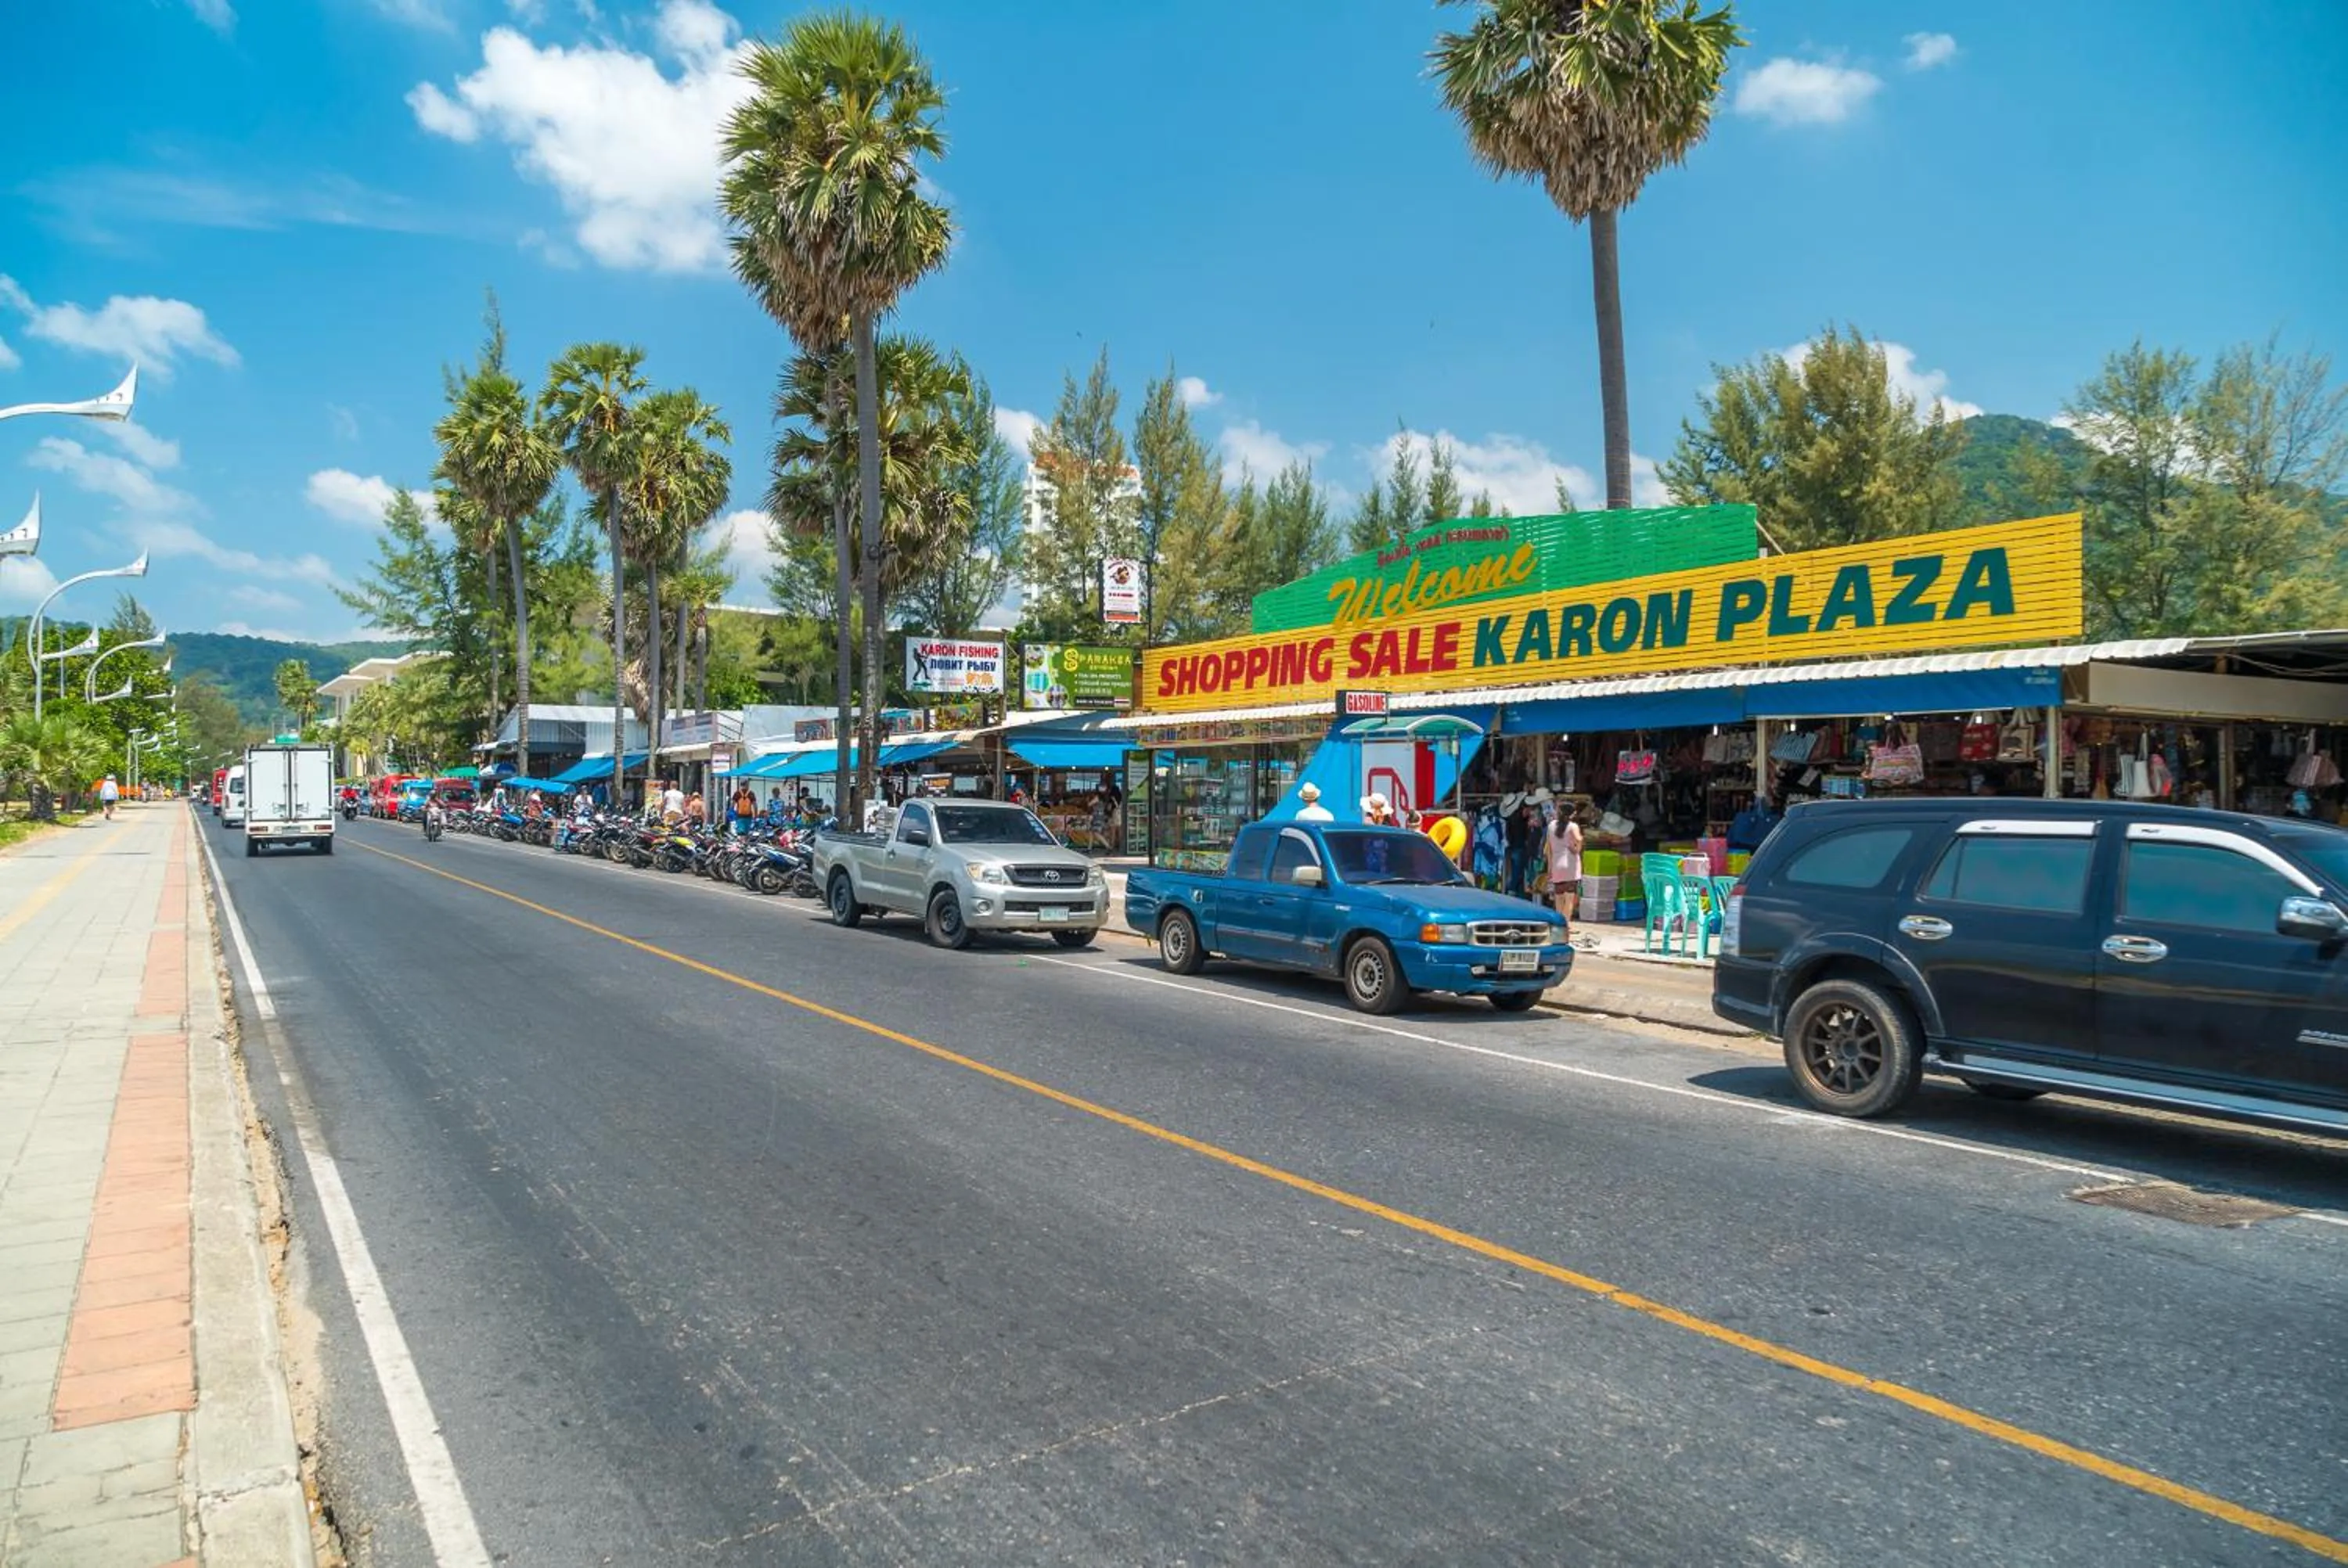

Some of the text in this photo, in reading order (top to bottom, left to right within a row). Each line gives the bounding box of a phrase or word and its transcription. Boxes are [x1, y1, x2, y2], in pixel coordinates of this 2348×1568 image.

[1327, 542, 1539, 628] Welcome
[1158, 547, 2015, 697] SHOPPING SALE KARON PLAZA
[920, 643, 999, 658] KARON FISHING
[930, 658, 996, 672] ЛОВИТ РЫБУ
[1347, 693, 1385, 712] GASOLINE
